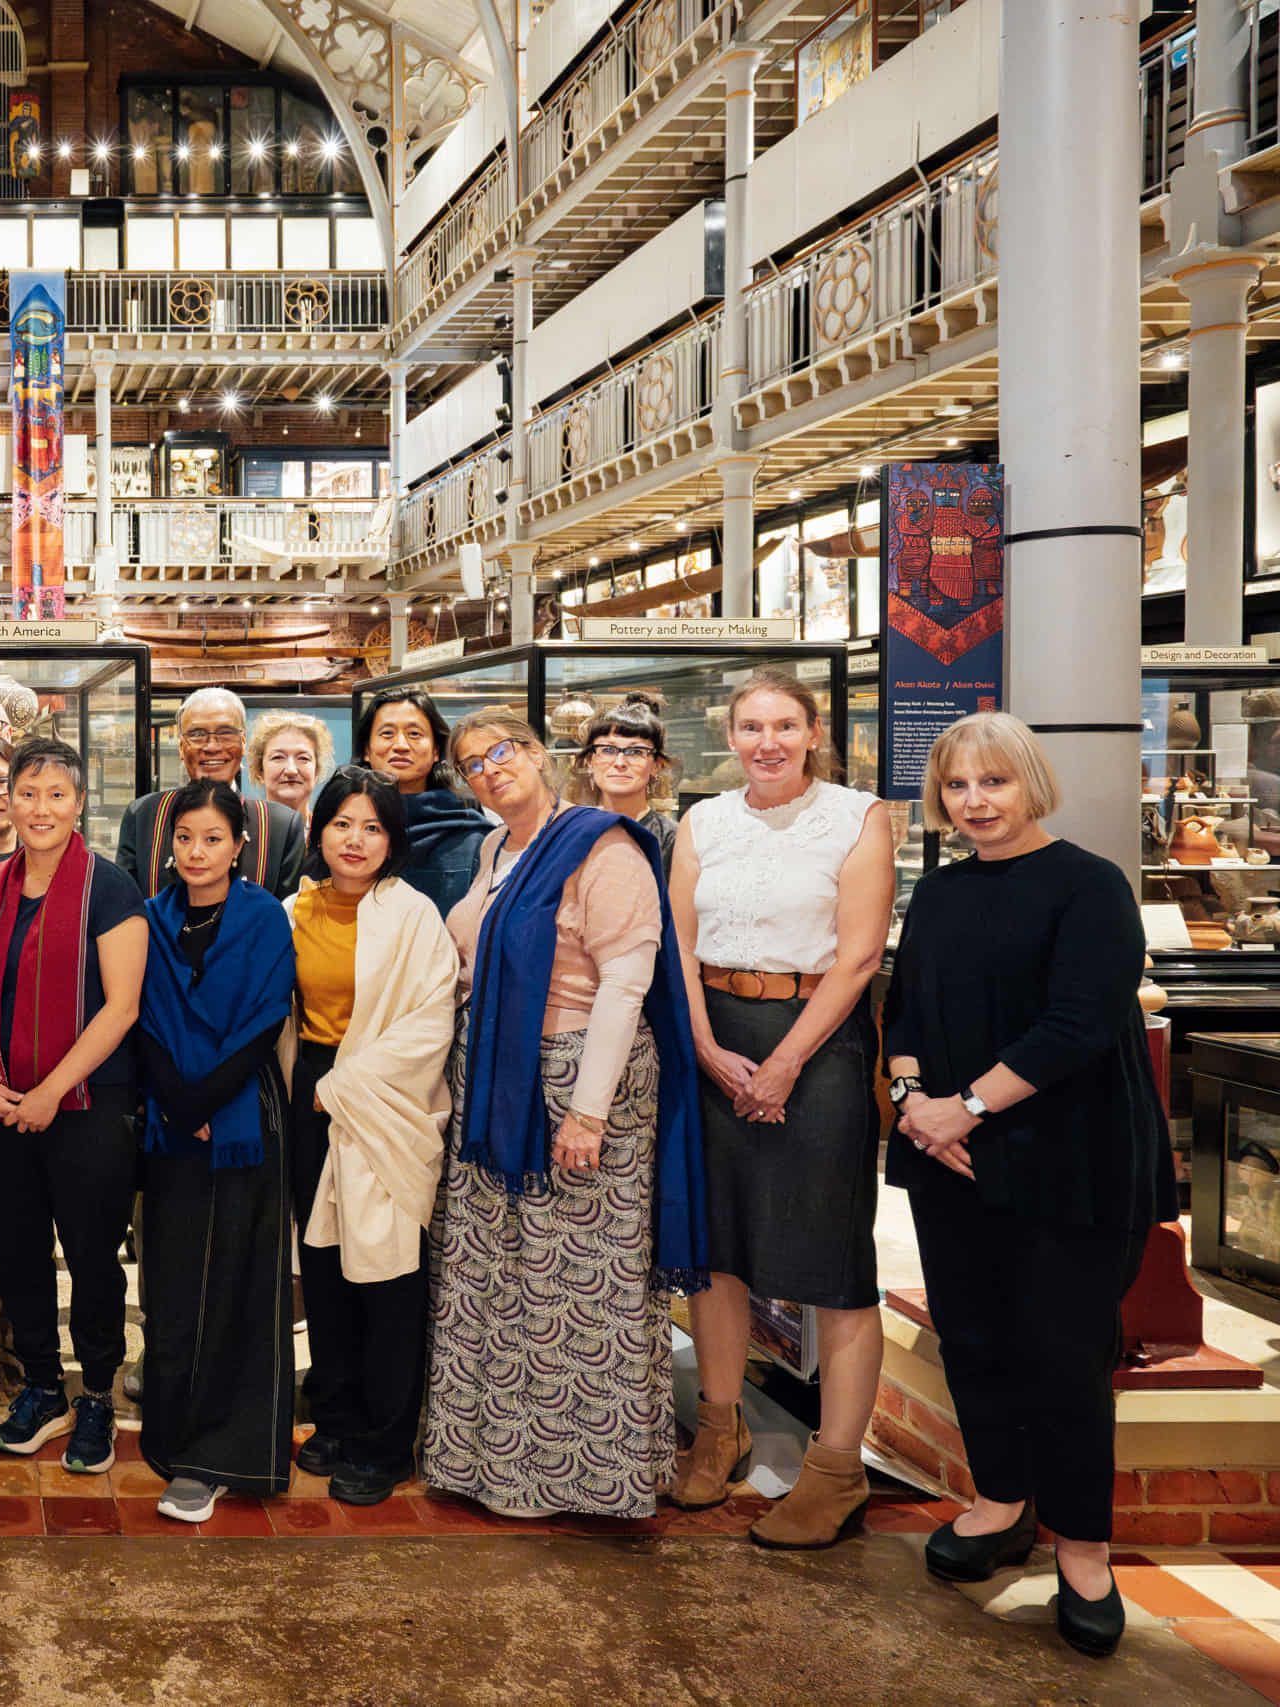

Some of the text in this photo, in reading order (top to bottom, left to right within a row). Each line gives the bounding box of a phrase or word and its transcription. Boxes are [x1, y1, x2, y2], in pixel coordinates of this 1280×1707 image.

[12, 626, 61, 637] America
[610, 624, 768, 638] Pottery and Pottery Making
[1150, 650, 1182, 662] Design
[1185, 650, 1201, 659] and
[1204, 650, 1257, 660] Decoration
